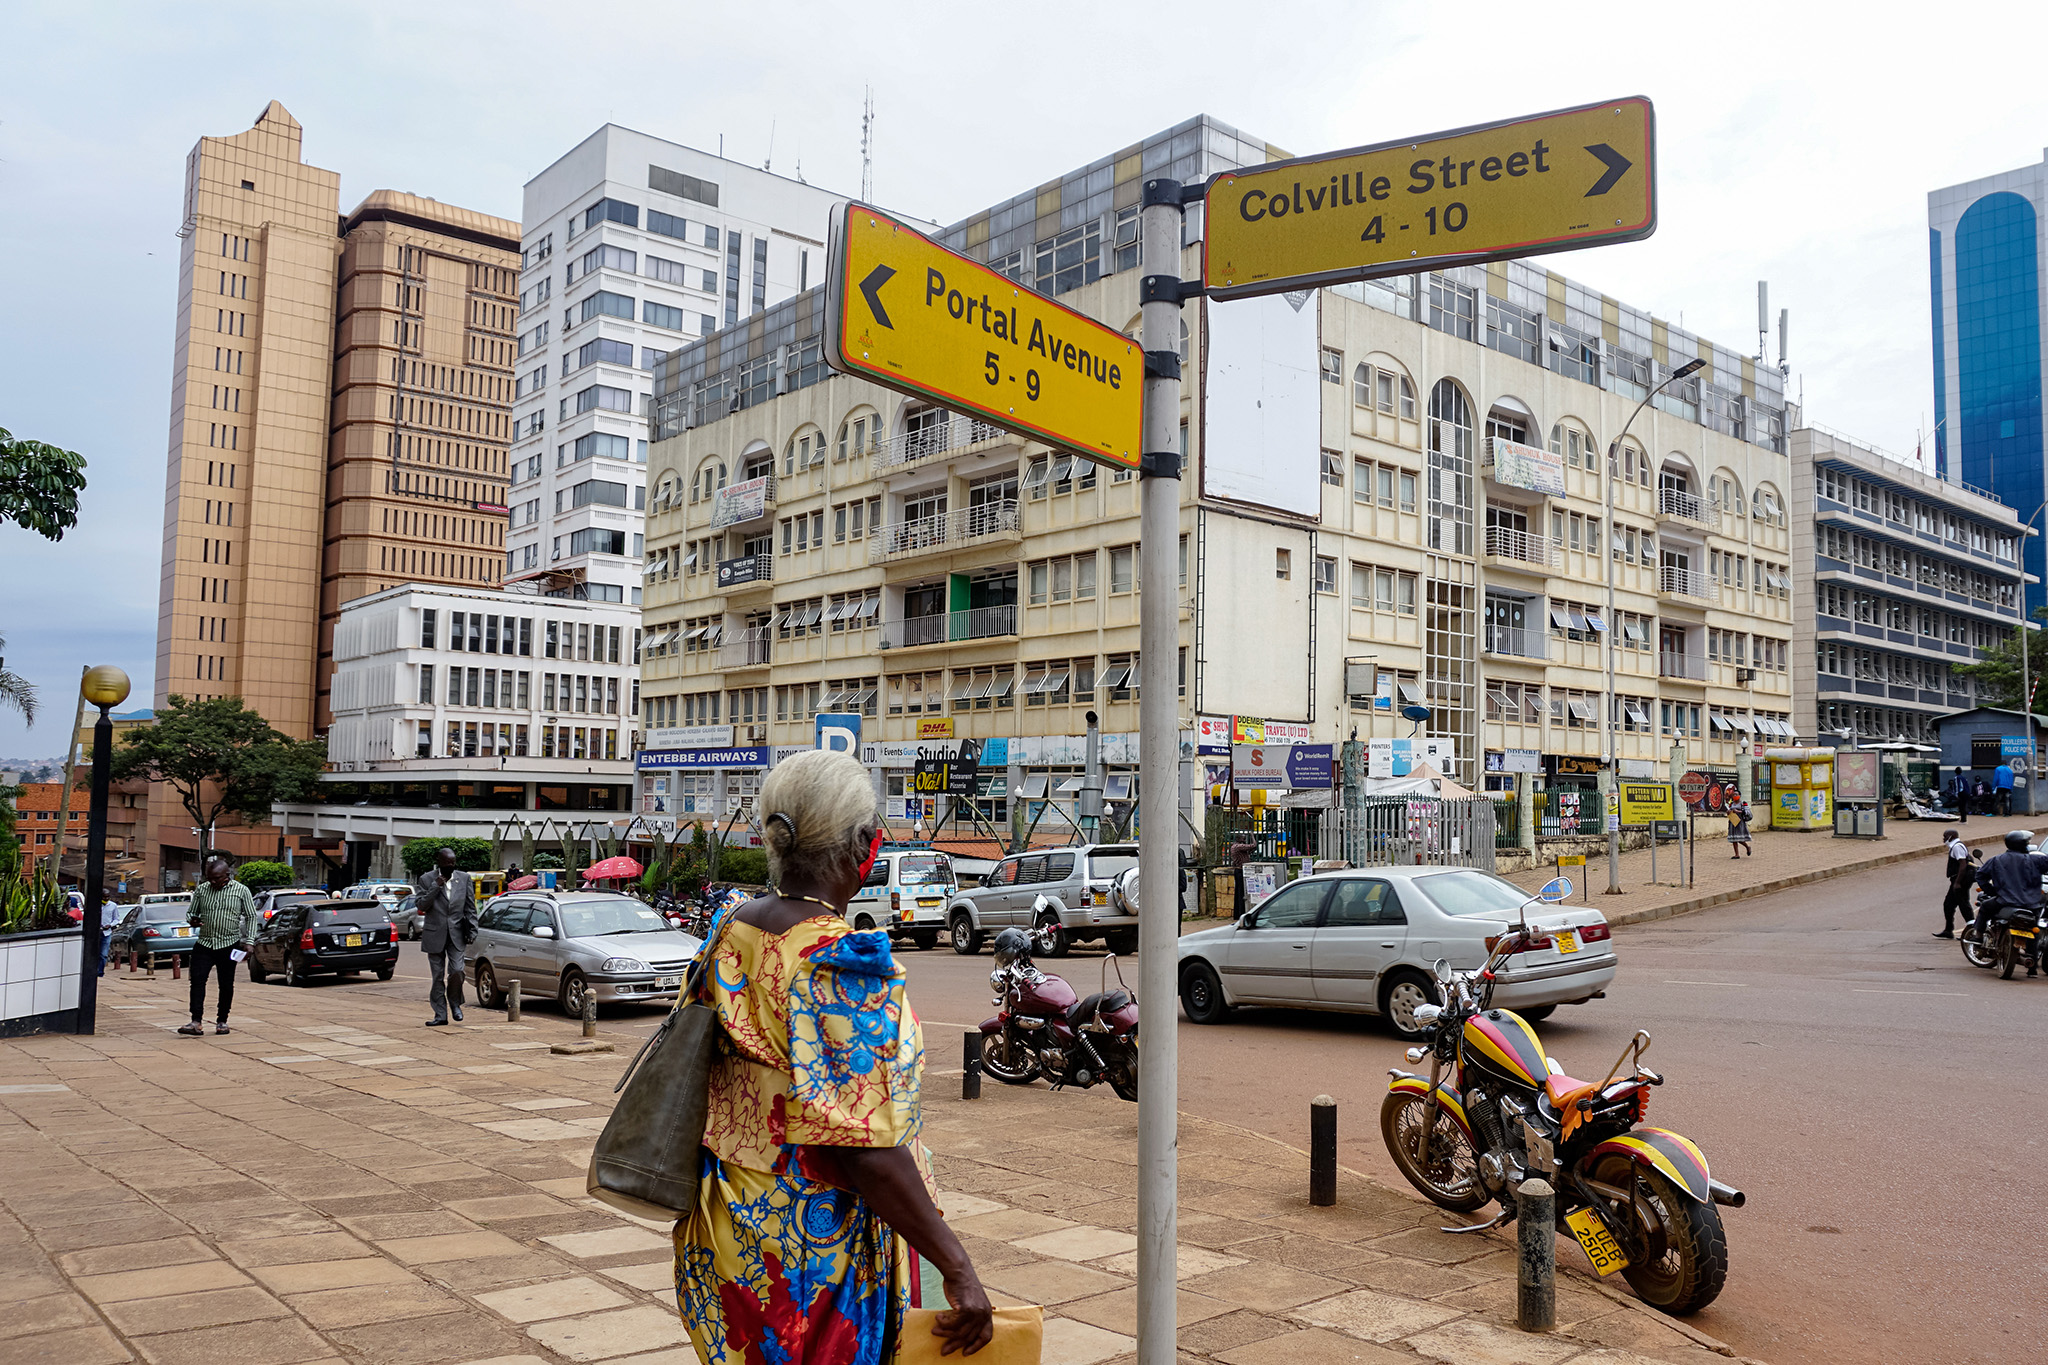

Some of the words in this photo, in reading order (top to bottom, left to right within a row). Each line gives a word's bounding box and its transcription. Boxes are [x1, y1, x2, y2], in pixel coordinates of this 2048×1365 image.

[1240, 171, 1391, 222] Colville
[1406, 138, 1550, 194] Street
[1361, 215, 1386, 244] 4
[1424, 201, 1468, 236] 10
[925, 266, 1018, 346] Portal
[1027, 317, 1122, 391] Avenue
[984, 350, 1000, 385] 5
[1026, 369, 1040, 401] 9
[922, 723, 948, 733] DHL
[1201, 721, 1211, 735] S
[1233, 715, 1245, 741] L
[1238, 716, 1264, 725] DDEMBE
[1265, 725, 1287, 737] TRAVEL
[1288, 726, 1297, 738] (U)
[1297, 727, 1308, 737] LTD
[641, 753, 696, 764] ENTEBBE
[698, 751, 758, 762] AIRWAYS
[864, 747, 878, 763] LTD.
[917, 744, 958, 760] Studio
[1250, 749, 1264, 767] S
[1595, 1230, 1624, 1261] UEB
